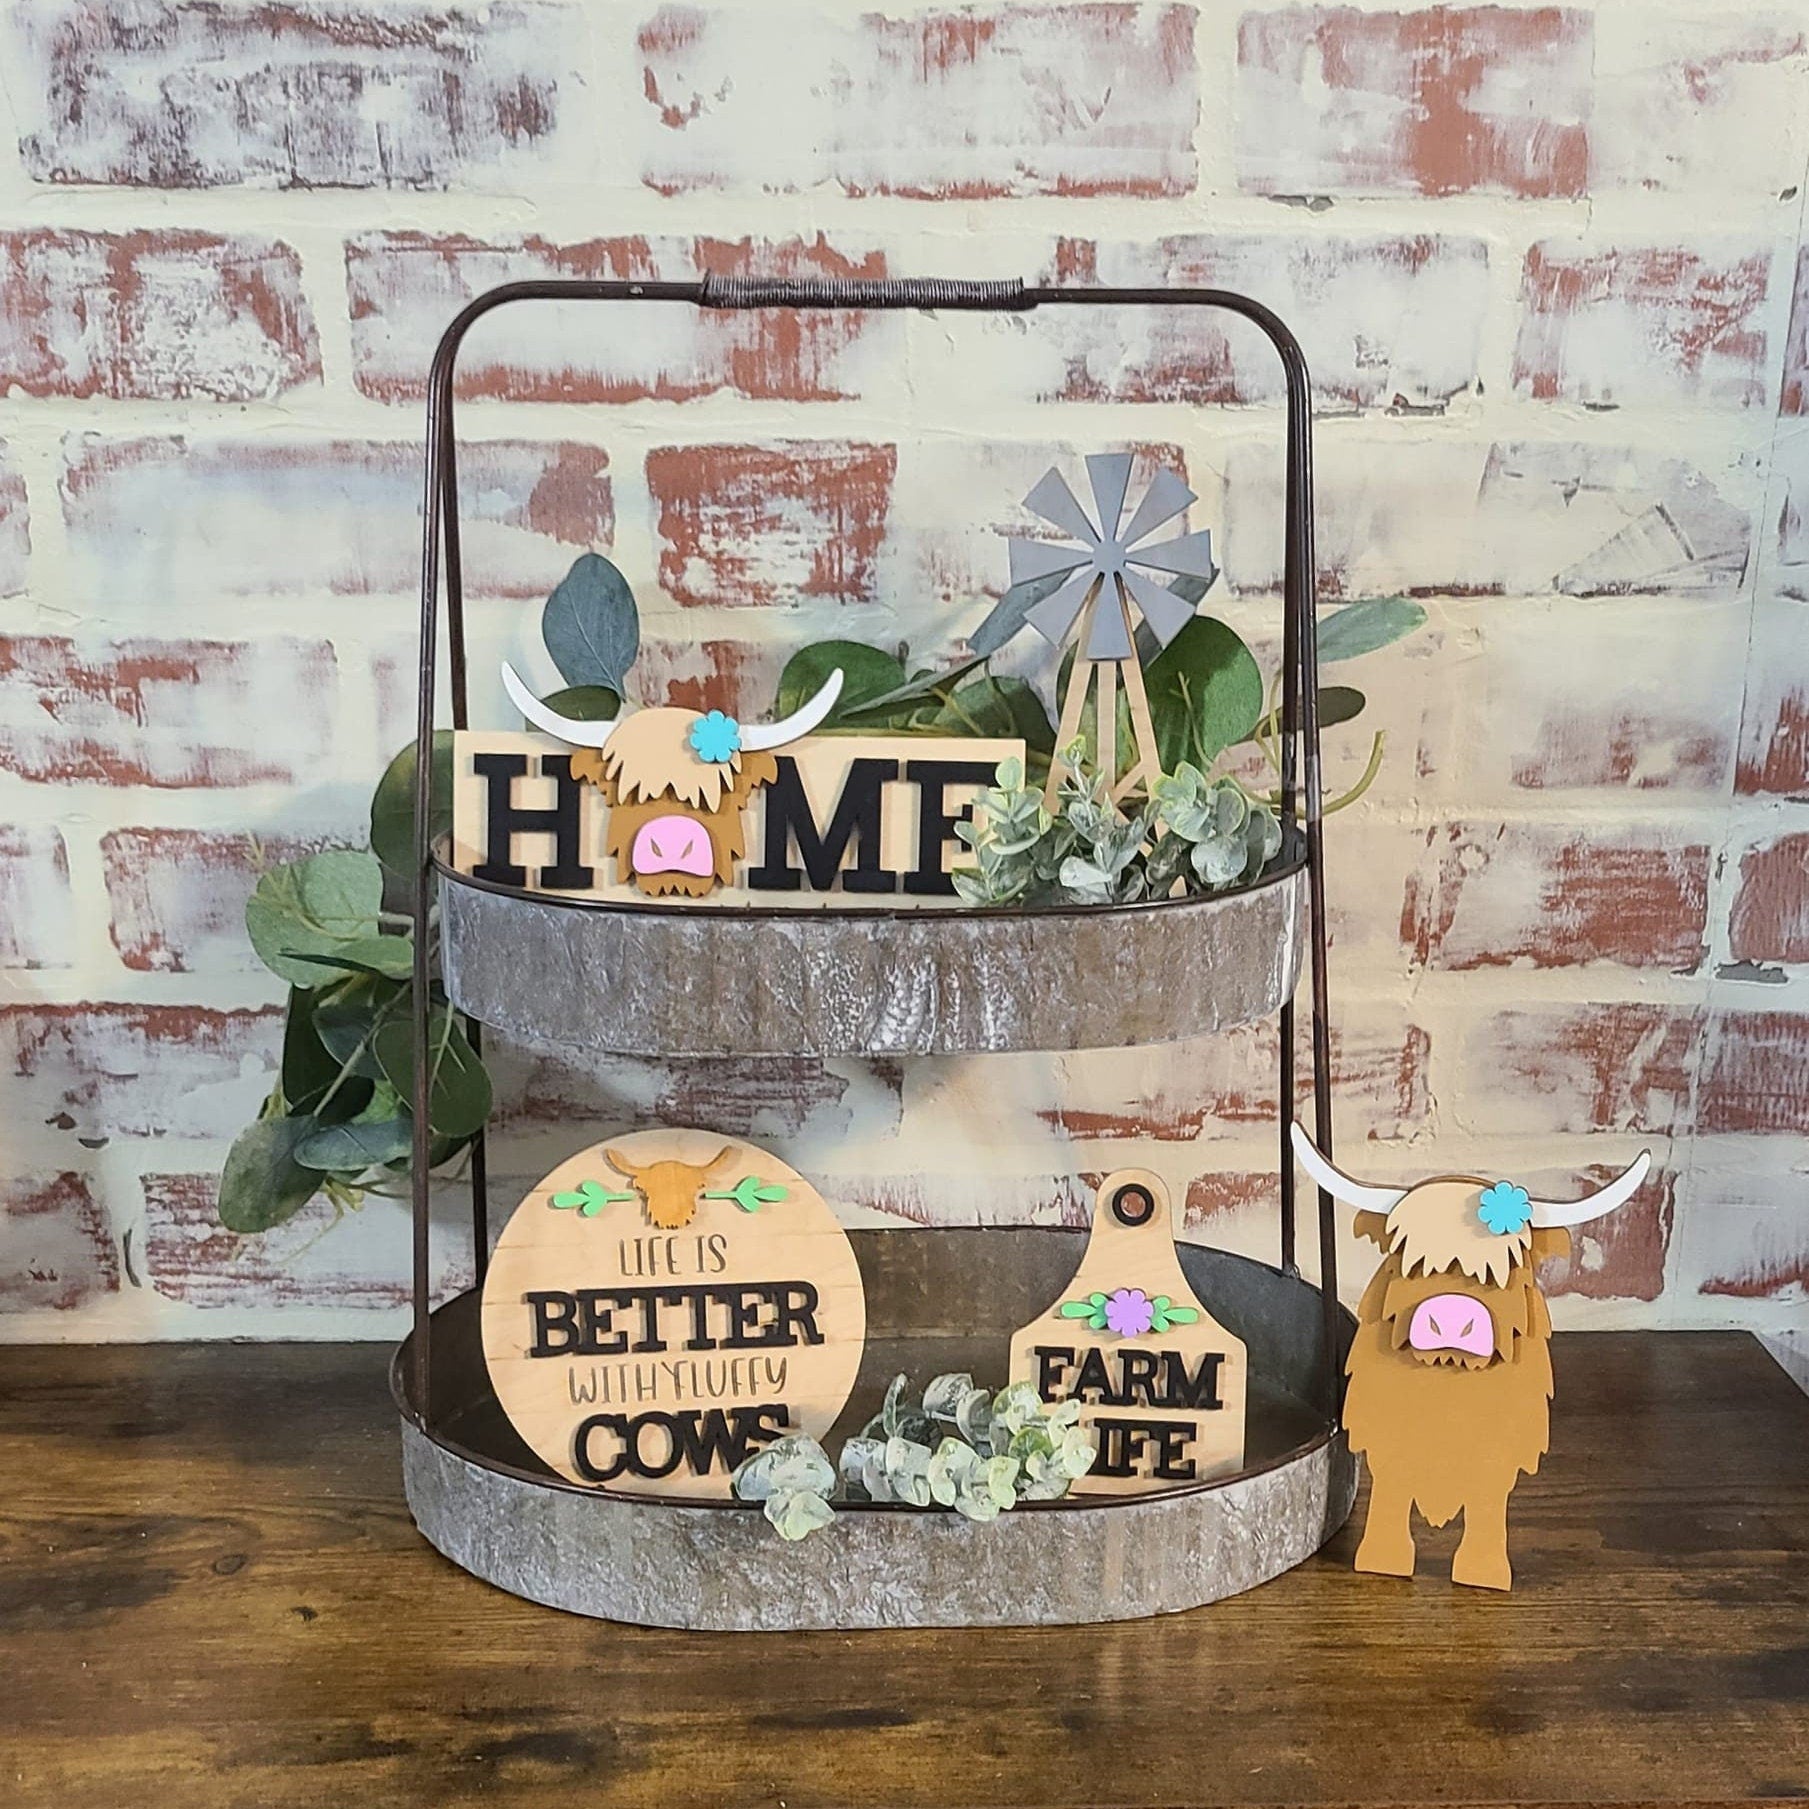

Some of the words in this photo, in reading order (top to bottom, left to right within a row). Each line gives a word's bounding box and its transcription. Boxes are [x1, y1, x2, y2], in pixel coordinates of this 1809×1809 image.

[473, 752, 1002, 895] HME
[618, 1235, 682, 1277] LIFE
[697, 1233, 728, 1274] IS
[524, 1280, 825, 1359] BETTER
[568, 1362, 658, 1404] WITH
[1033, 1345, 1226, 1410] FARM
[1065, 1417, 1197, 1479] IFE
